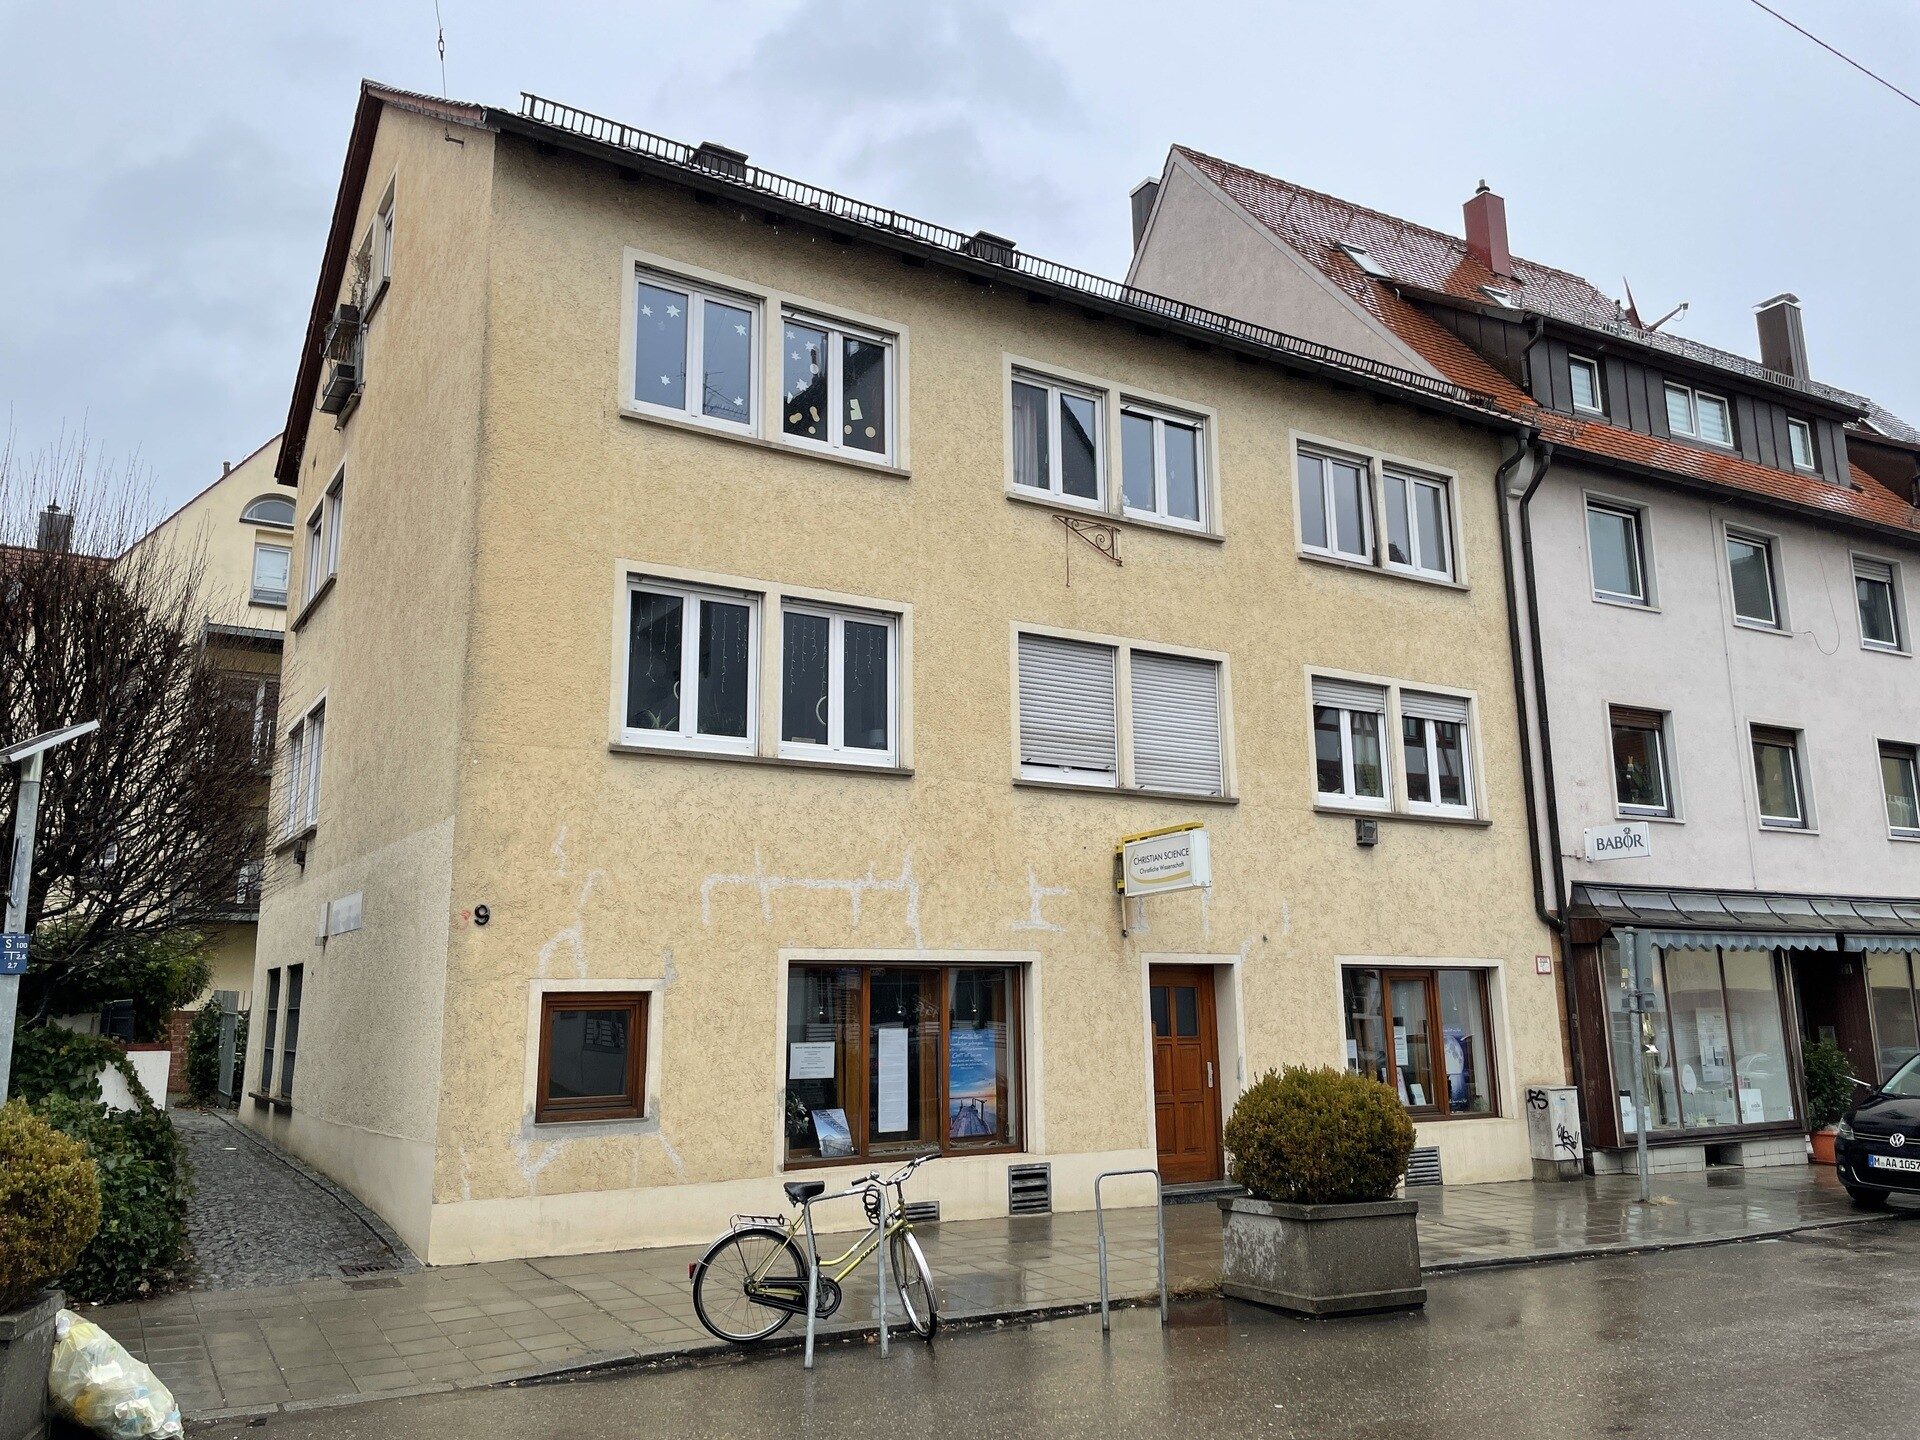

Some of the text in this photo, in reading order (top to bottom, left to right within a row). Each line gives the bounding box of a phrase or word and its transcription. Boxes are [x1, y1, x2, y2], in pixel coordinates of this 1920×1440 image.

[1596, 831, 1644, 851] BABOR
[1133, 847, 1190, 866] CHRISTIAN SCIENCE
[1139, 861, 1185, 875] Christliche Wissenschaft
[474, 904, 490, 926] 9
[5, 939, 12, 949] S
